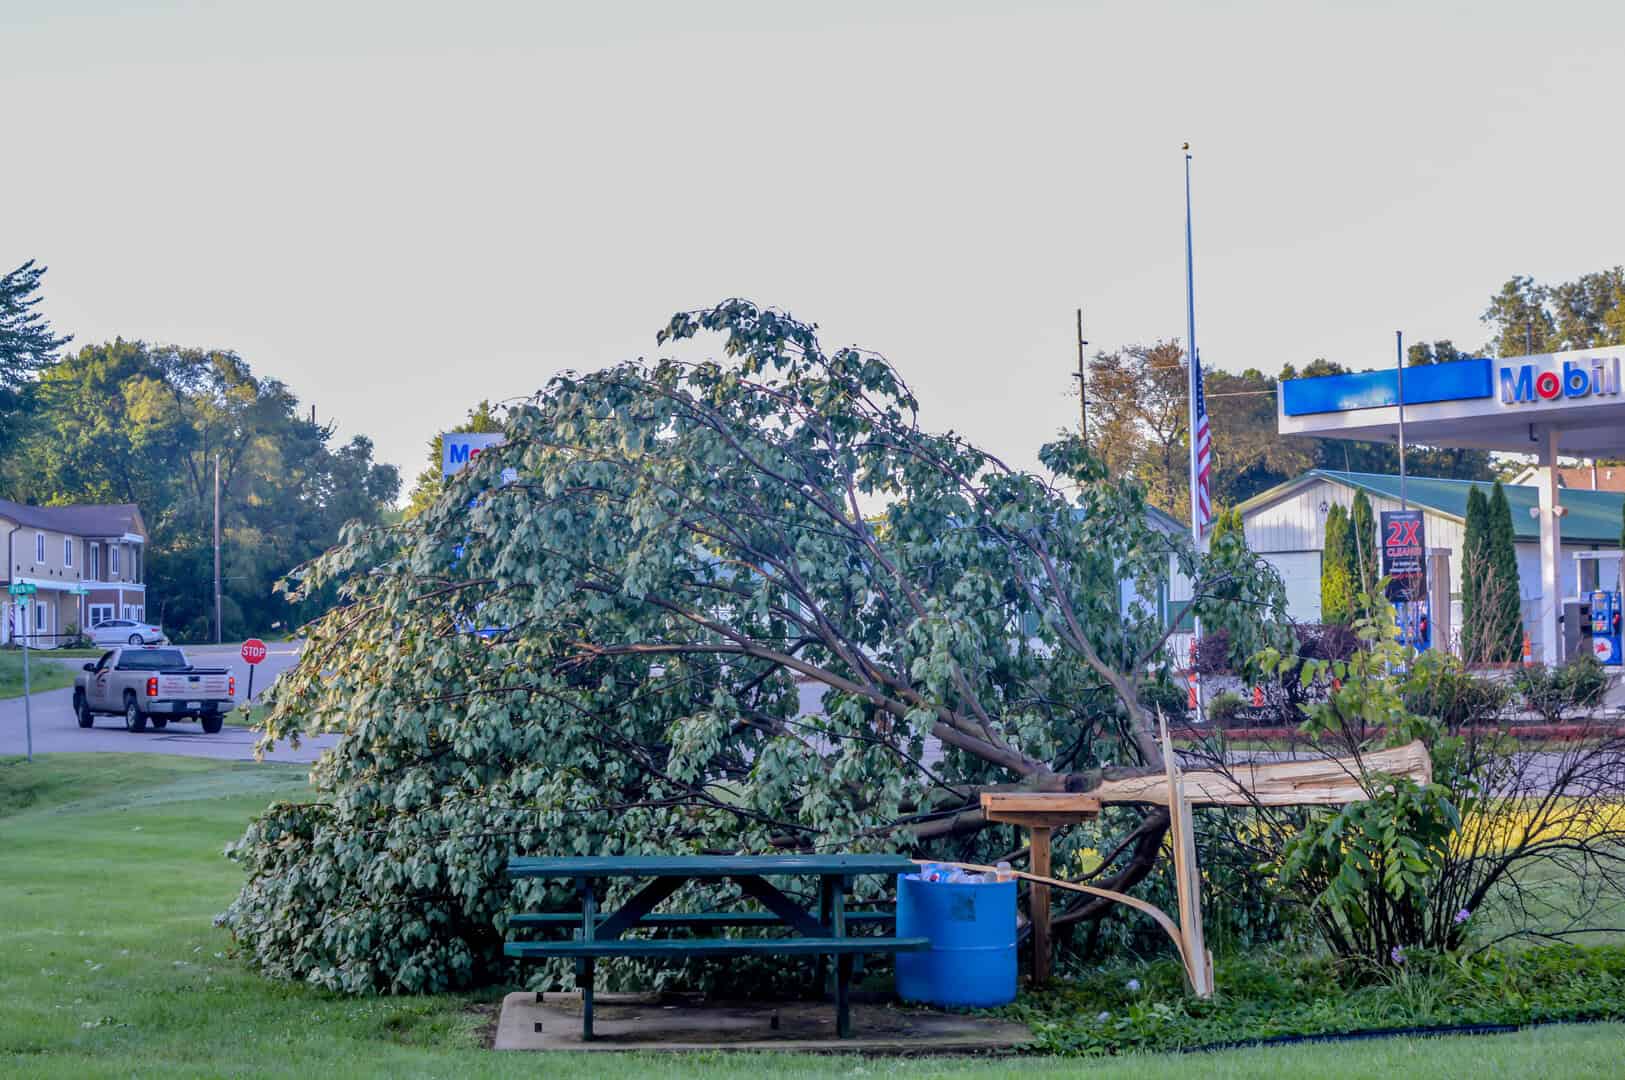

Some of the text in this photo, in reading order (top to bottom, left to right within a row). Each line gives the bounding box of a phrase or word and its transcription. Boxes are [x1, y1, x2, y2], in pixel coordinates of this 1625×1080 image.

[1500, 358, 1620, 403] Mobil
[1387, 520, 1420, 545] 2X
[242, 646, 265, 657] STOP
